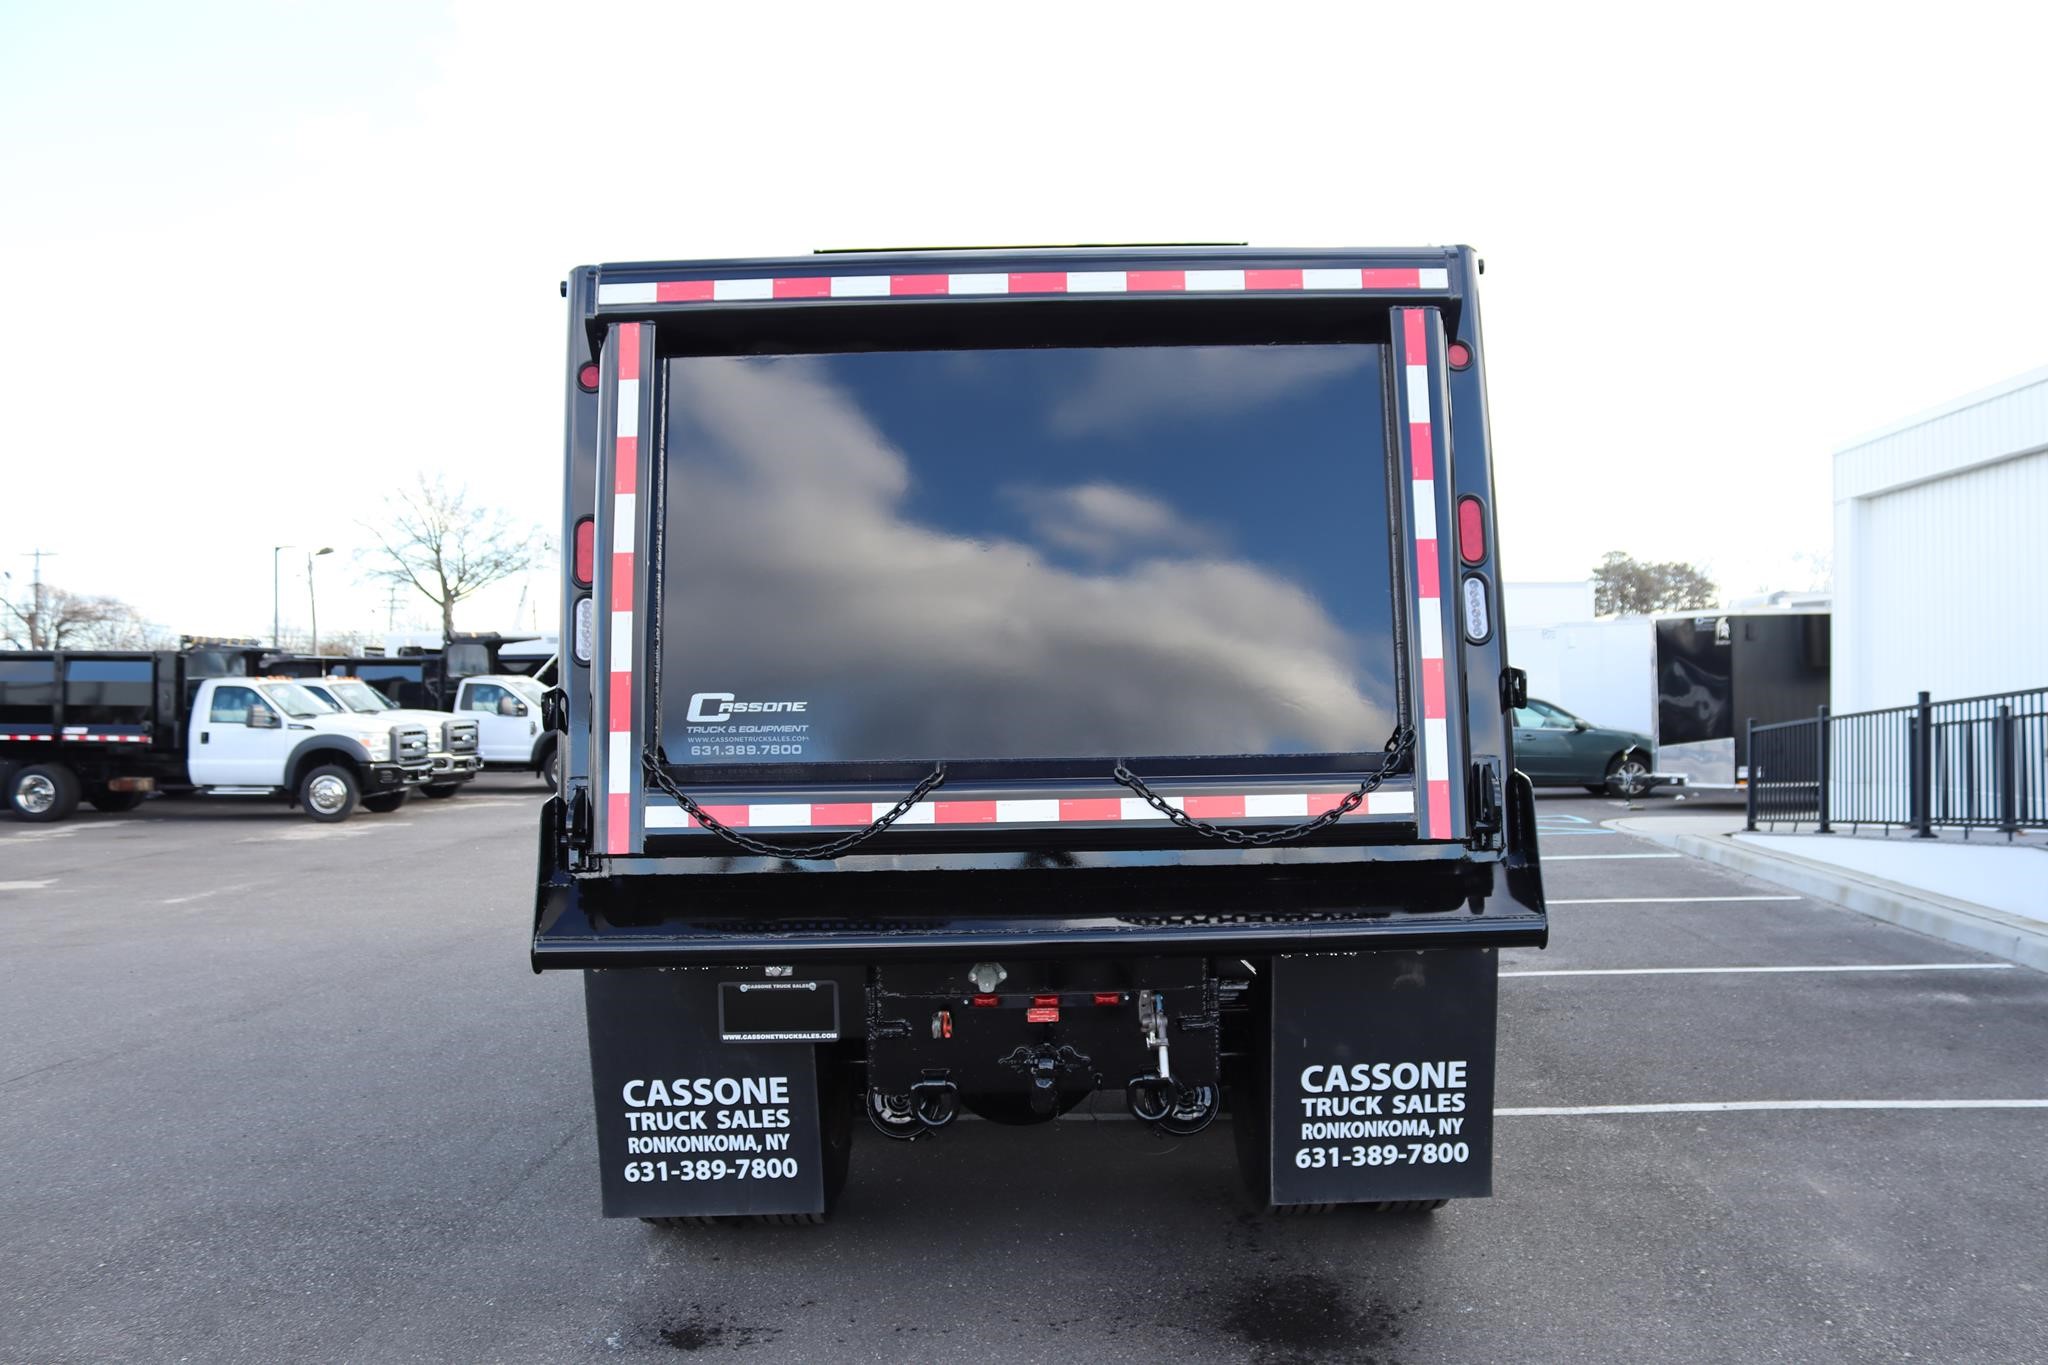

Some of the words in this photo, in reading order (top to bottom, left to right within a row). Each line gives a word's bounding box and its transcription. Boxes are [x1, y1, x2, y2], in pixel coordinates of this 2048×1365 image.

[739, 725, 809, 733] EQUIPMENT
[691, 744, 802, 755] 631.389.7800
[1301, 1061, 1467, 1093] CASSONE
[623, 1077, 790, 1107] CASSONE
[1301, 1096, 1383, 1117] TRUCK
[1392, 1093, 1466, 1114] SALES
[625, 1111, 707, 1131] TRUCK
[716, 1109, 790, 1129] SALES
[1301, 1119, 1436, 1140] RONKONKOMA,
[1439, 1118, 1464, 1135] NY
[628, 1134, 762, 1154] RONKONKOMA,
[765, 1133, 790, 1150] NY
[1295, 1142, 1470, 1169] 631-389-7800
[624, 1158, 798, 1182] 631-389-7800
